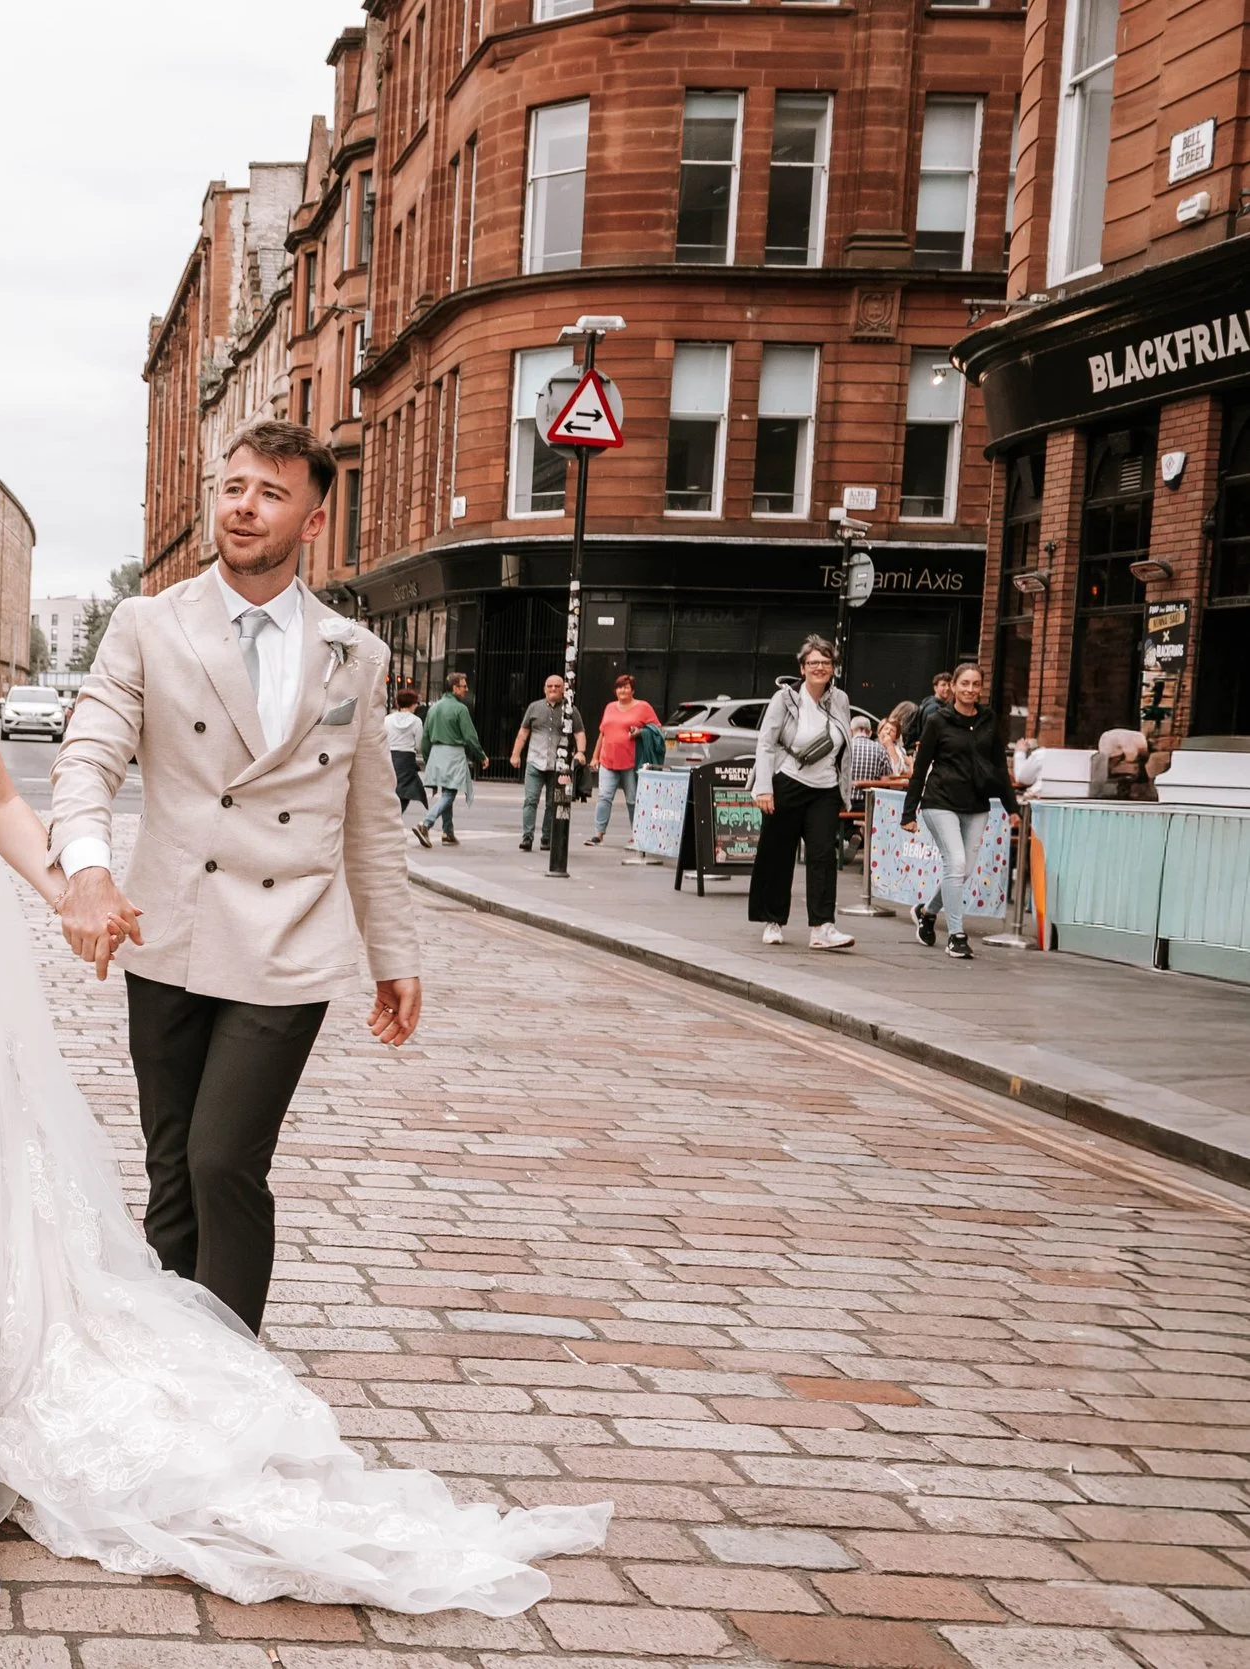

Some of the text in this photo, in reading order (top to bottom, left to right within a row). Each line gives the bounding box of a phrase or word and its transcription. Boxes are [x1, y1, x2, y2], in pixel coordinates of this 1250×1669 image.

[1182, 131, 1200, 150] BELL
[1176, 144, 1206, 170] STREET
[1088, 309, 1250, 393] BLACKFRIA
[819, 565, 963, 591] Tsami Axis
[903, 842, 941, 861] BEAVER
